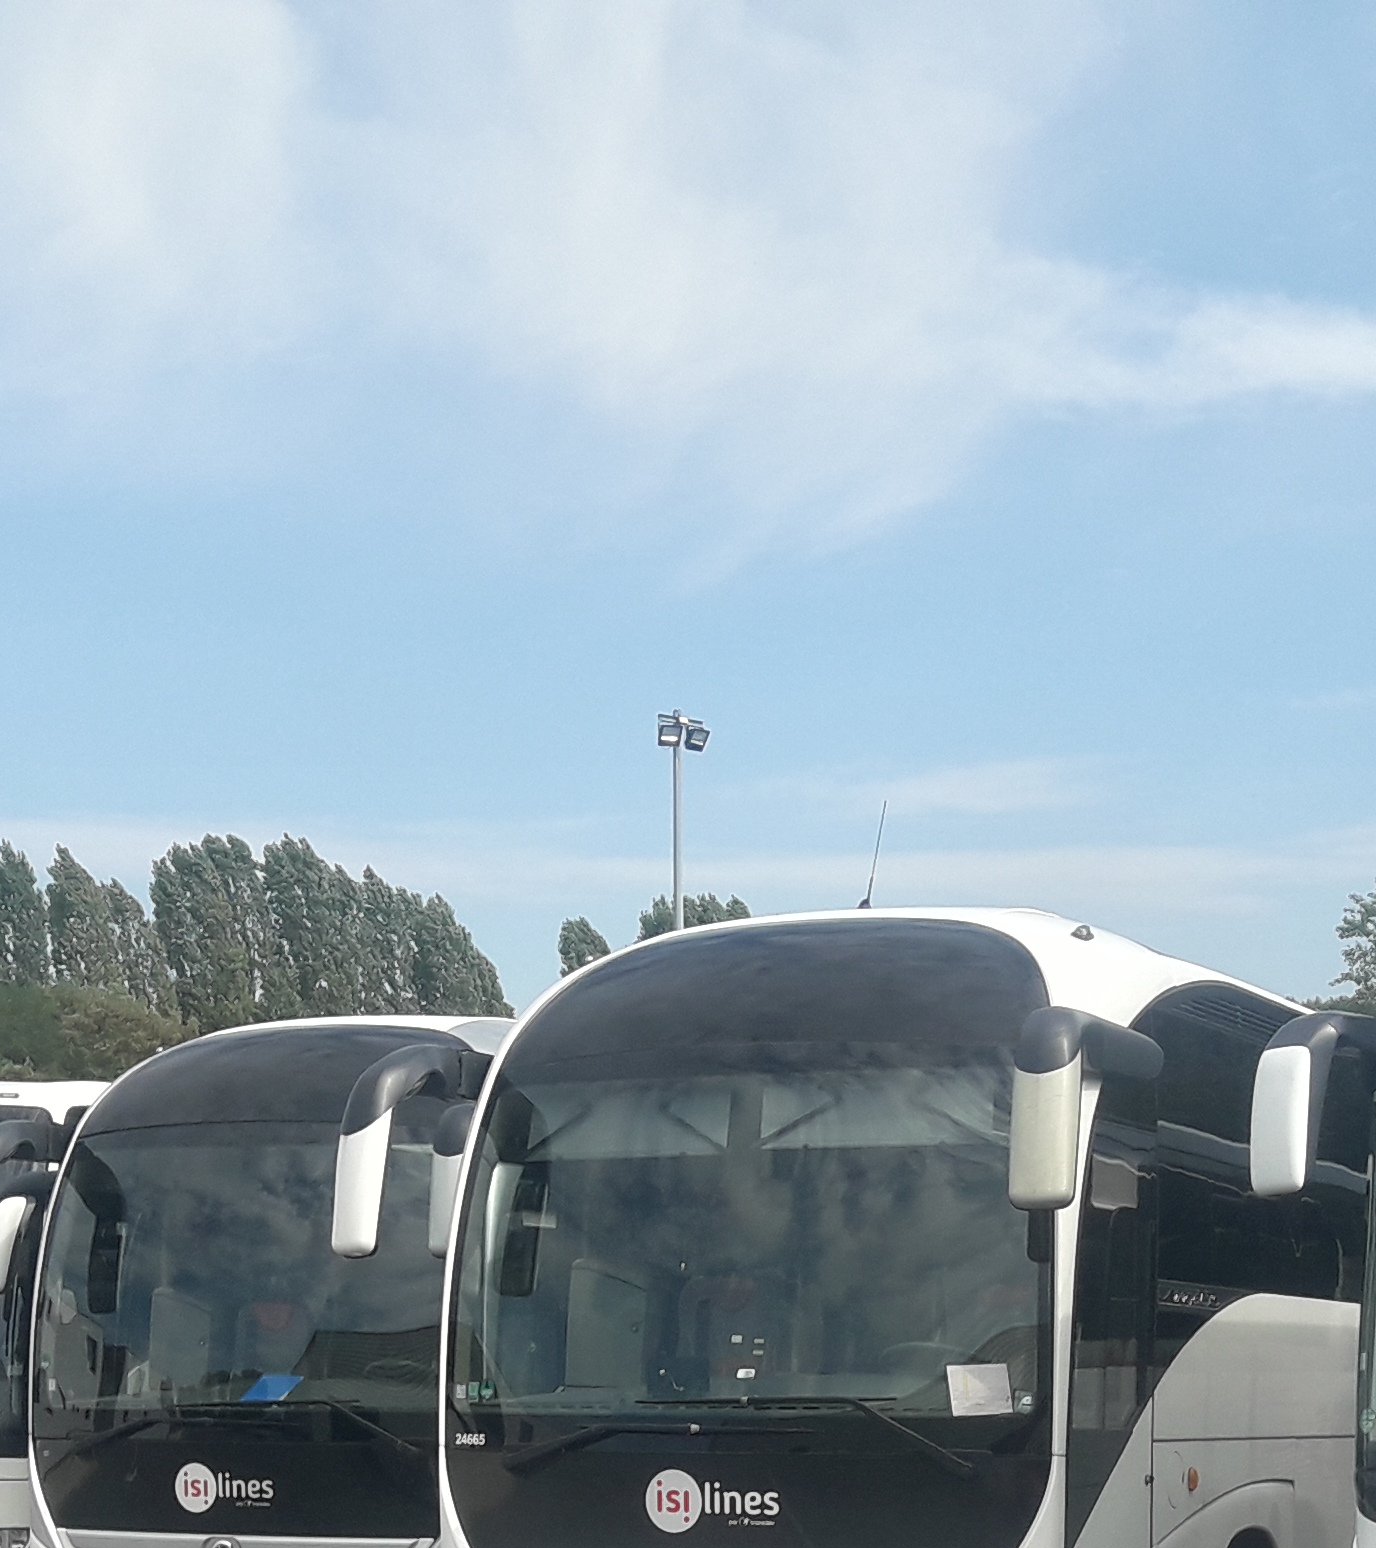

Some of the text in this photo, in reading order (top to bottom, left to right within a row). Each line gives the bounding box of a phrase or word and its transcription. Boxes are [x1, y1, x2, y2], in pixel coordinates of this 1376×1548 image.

[455, 1433, 486, 1446] 24665
[218, 1472, 274, 1499] lines
[704, 1481, 780, 1515] lines
